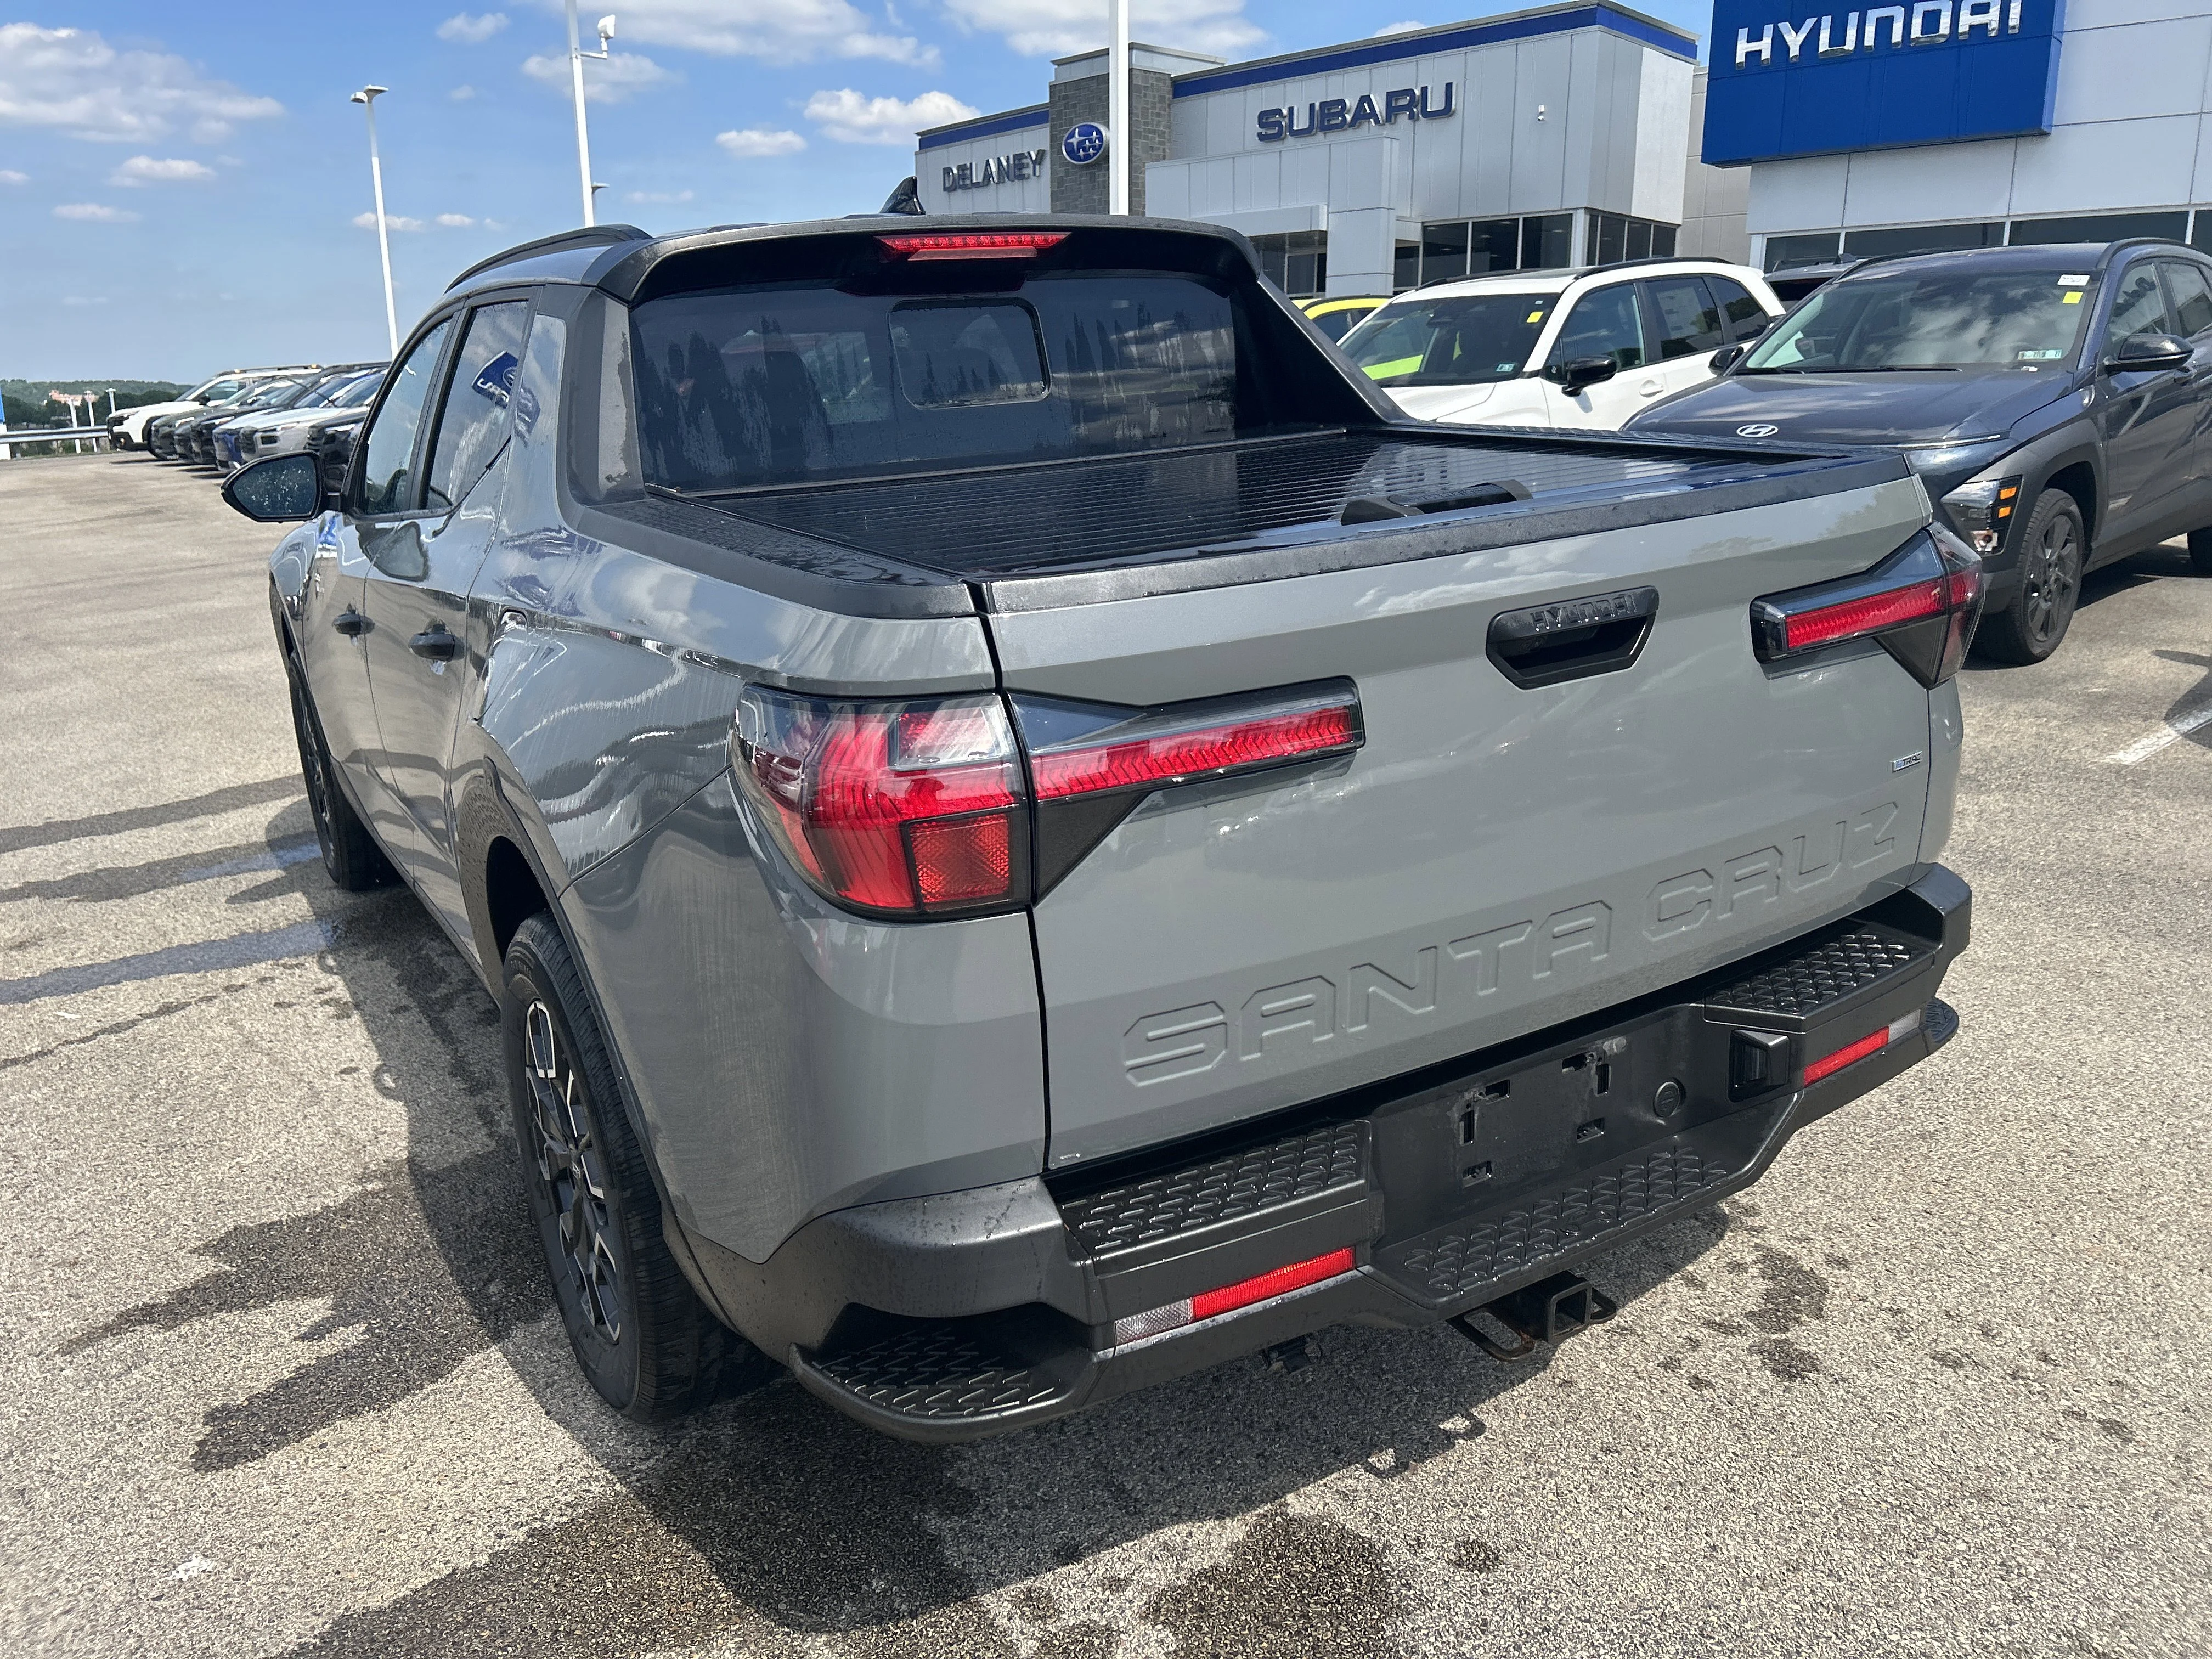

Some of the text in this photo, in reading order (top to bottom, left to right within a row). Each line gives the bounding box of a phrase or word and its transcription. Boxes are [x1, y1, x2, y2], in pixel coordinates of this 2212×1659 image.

[1735, 0, 2022, 70] HYUNDAI
[1256, 82, 1454, 142] SUBARU
[943, 149, 1046, 191] DELANEY
[1530, 594, 1637, 633] HYUNDAI
[1122, 800, 1899, 1088] SANTA CRUZ
